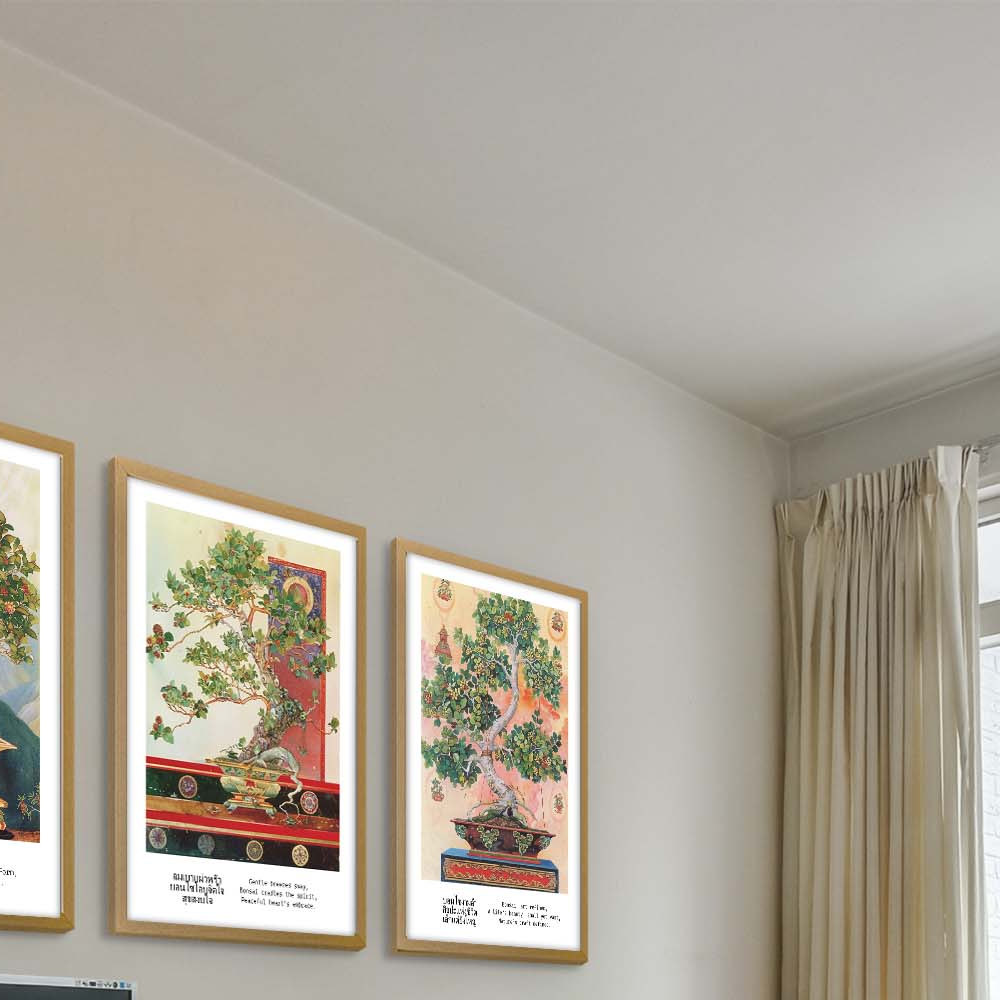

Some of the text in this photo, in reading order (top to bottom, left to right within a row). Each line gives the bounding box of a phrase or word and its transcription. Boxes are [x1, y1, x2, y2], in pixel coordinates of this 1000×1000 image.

[240, 886, 258, 895] Bonsai
[286, 890, 294, 898] the
[241, 896, 266, 906] Peaceful
